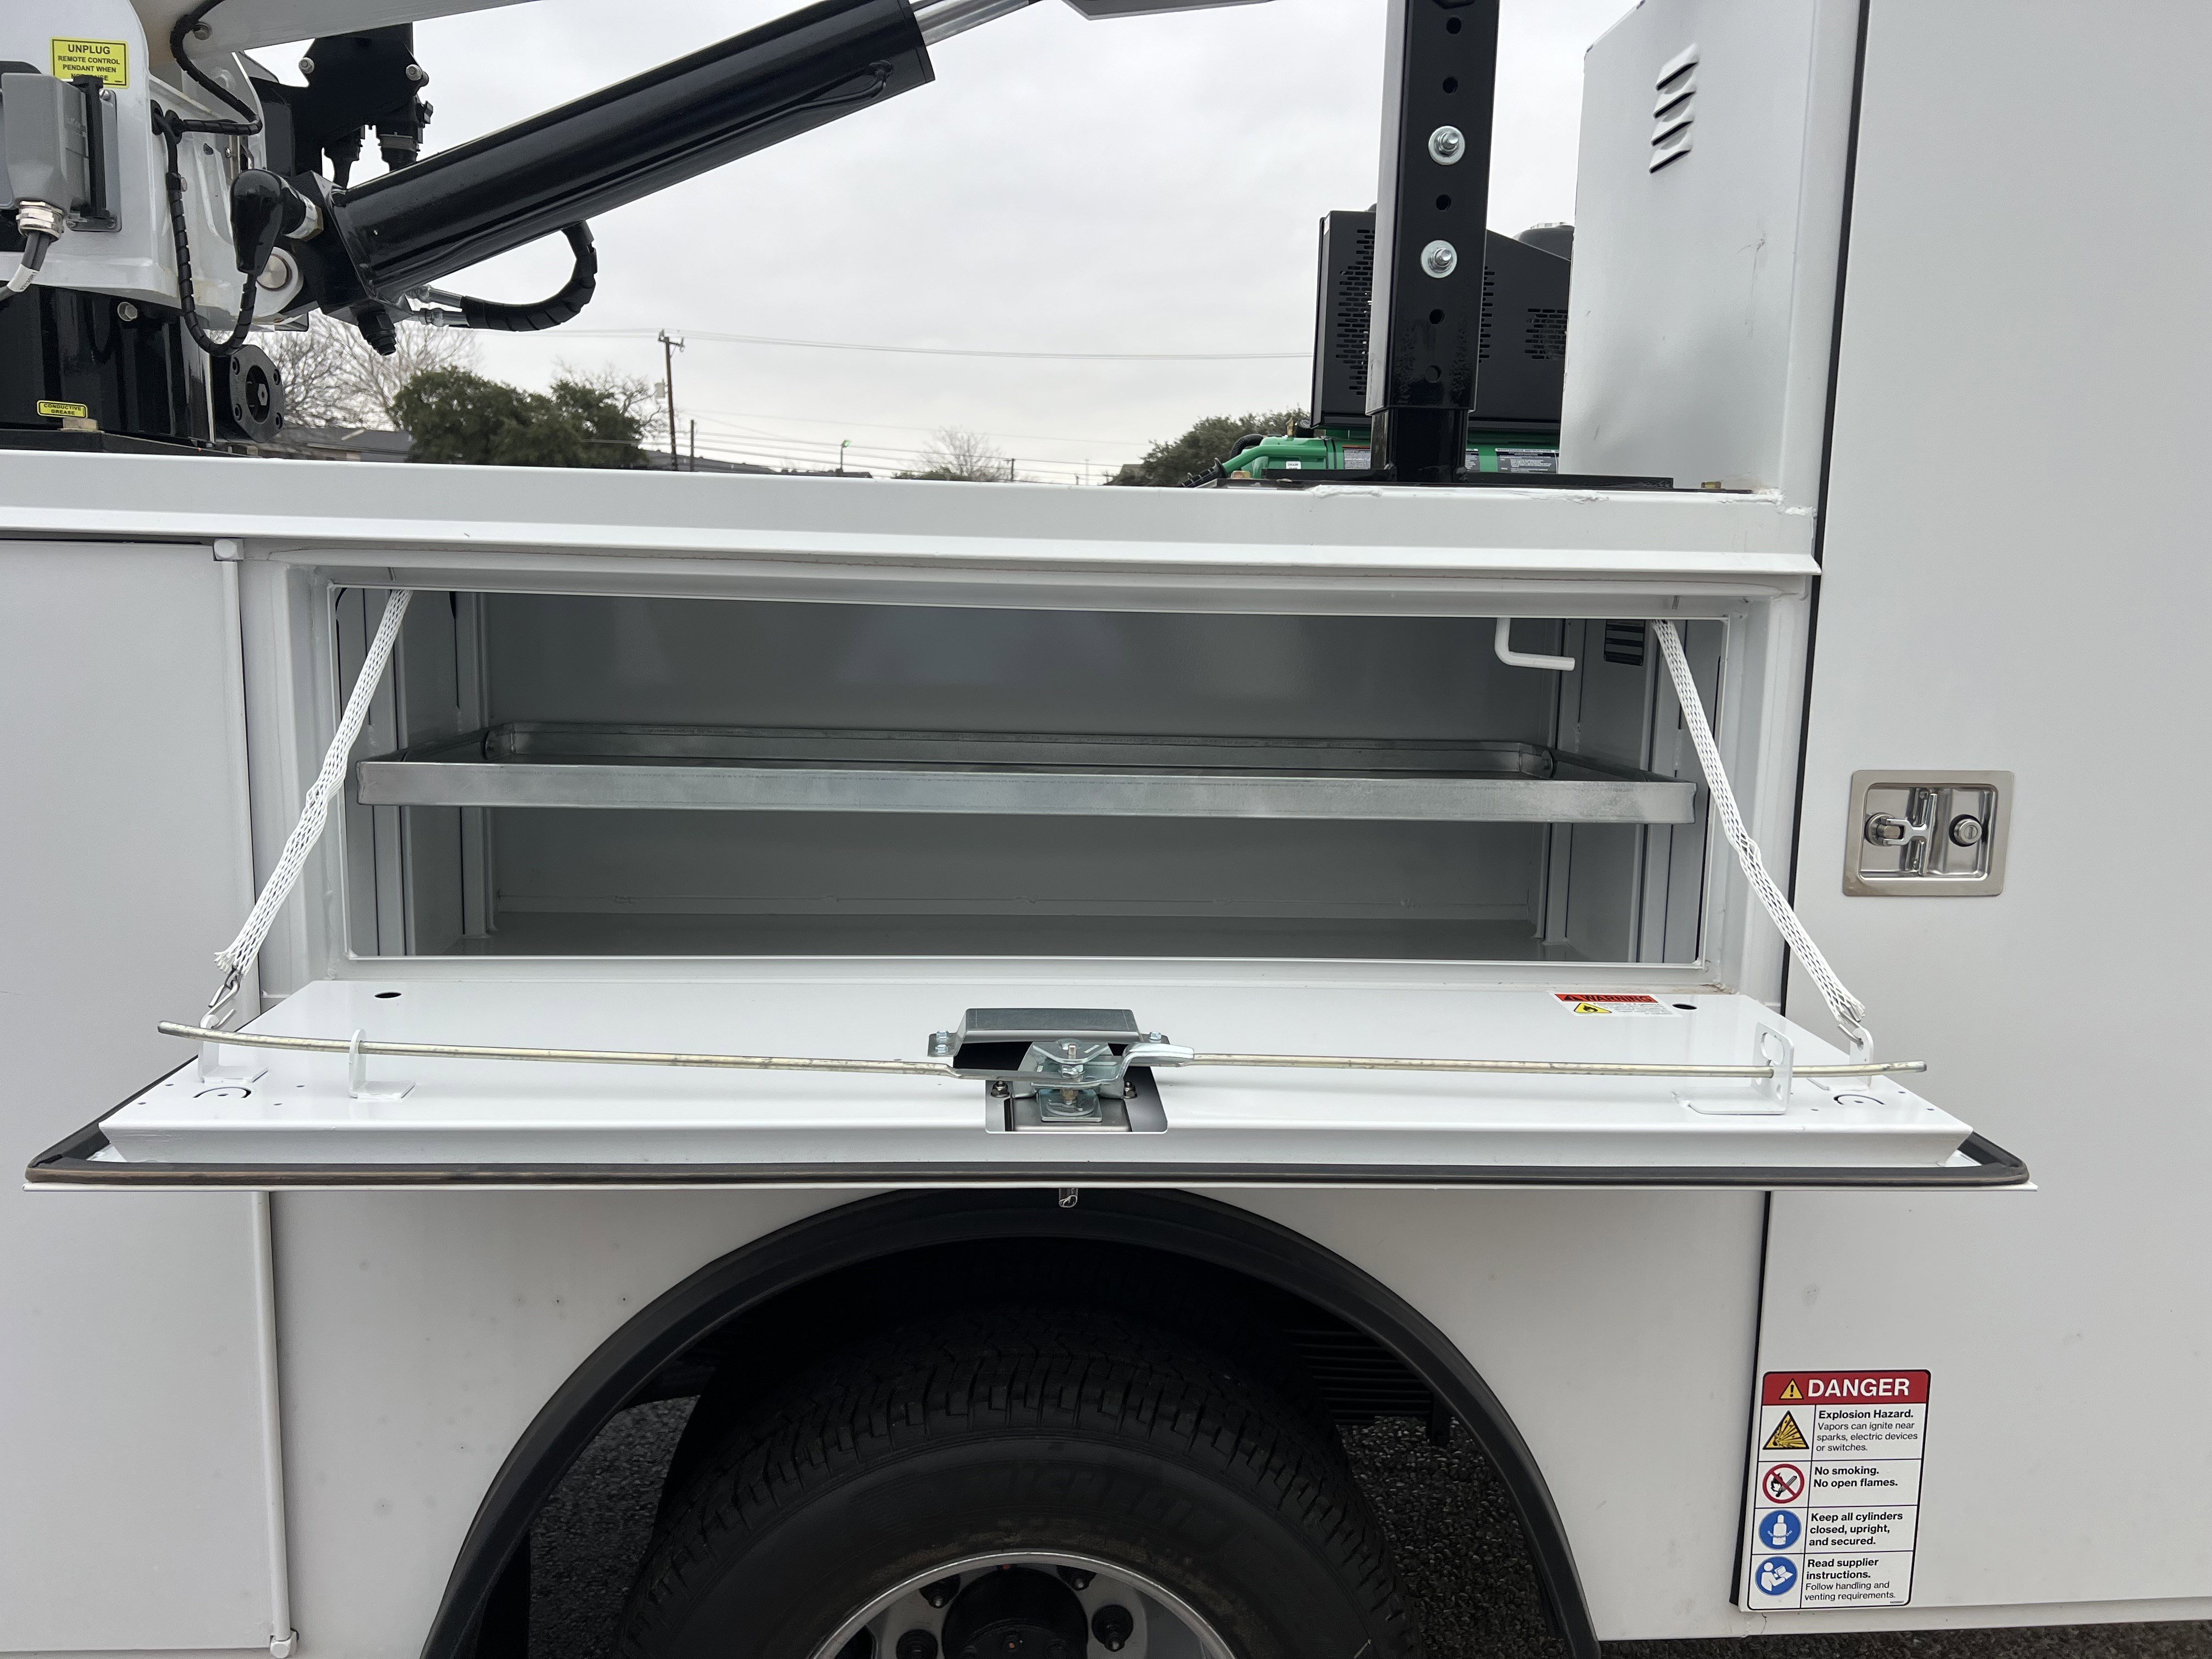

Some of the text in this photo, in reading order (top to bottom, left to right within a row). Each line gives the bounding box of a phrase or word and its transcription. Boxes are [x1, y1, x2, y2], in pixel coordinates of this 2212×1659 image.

[68, 44, 110, 54] UNPLUG
[1808, 1378, 1909, 1397] DANGER
[1819, 1409, 1914, 1420] Explosion Hazard.
[1818, 1423, 1848, 1431] Vapors
[1869, 1422, 1893, 1431] ignite
[1817, 1434, 1848, 1442] sparks,
[1815, 1466, 1879, 1476] No smoking.
[1814, 1478, 1898, 1488] No open flames.
[1811, 1512, 1903, 1522] Keep all cylinders
[1810, 1524, 1890, 1534] closed, upright,
[1809, 1537, 1876, 1546] and secured.
[1808, 1558, 1879, 1568] Read supplier
[1806, 1571, 1871, 1579] instructions.
[1836, 1582, 1871, 1590] handling
[1804, 1592, 1895, 1601] venting requirements.
